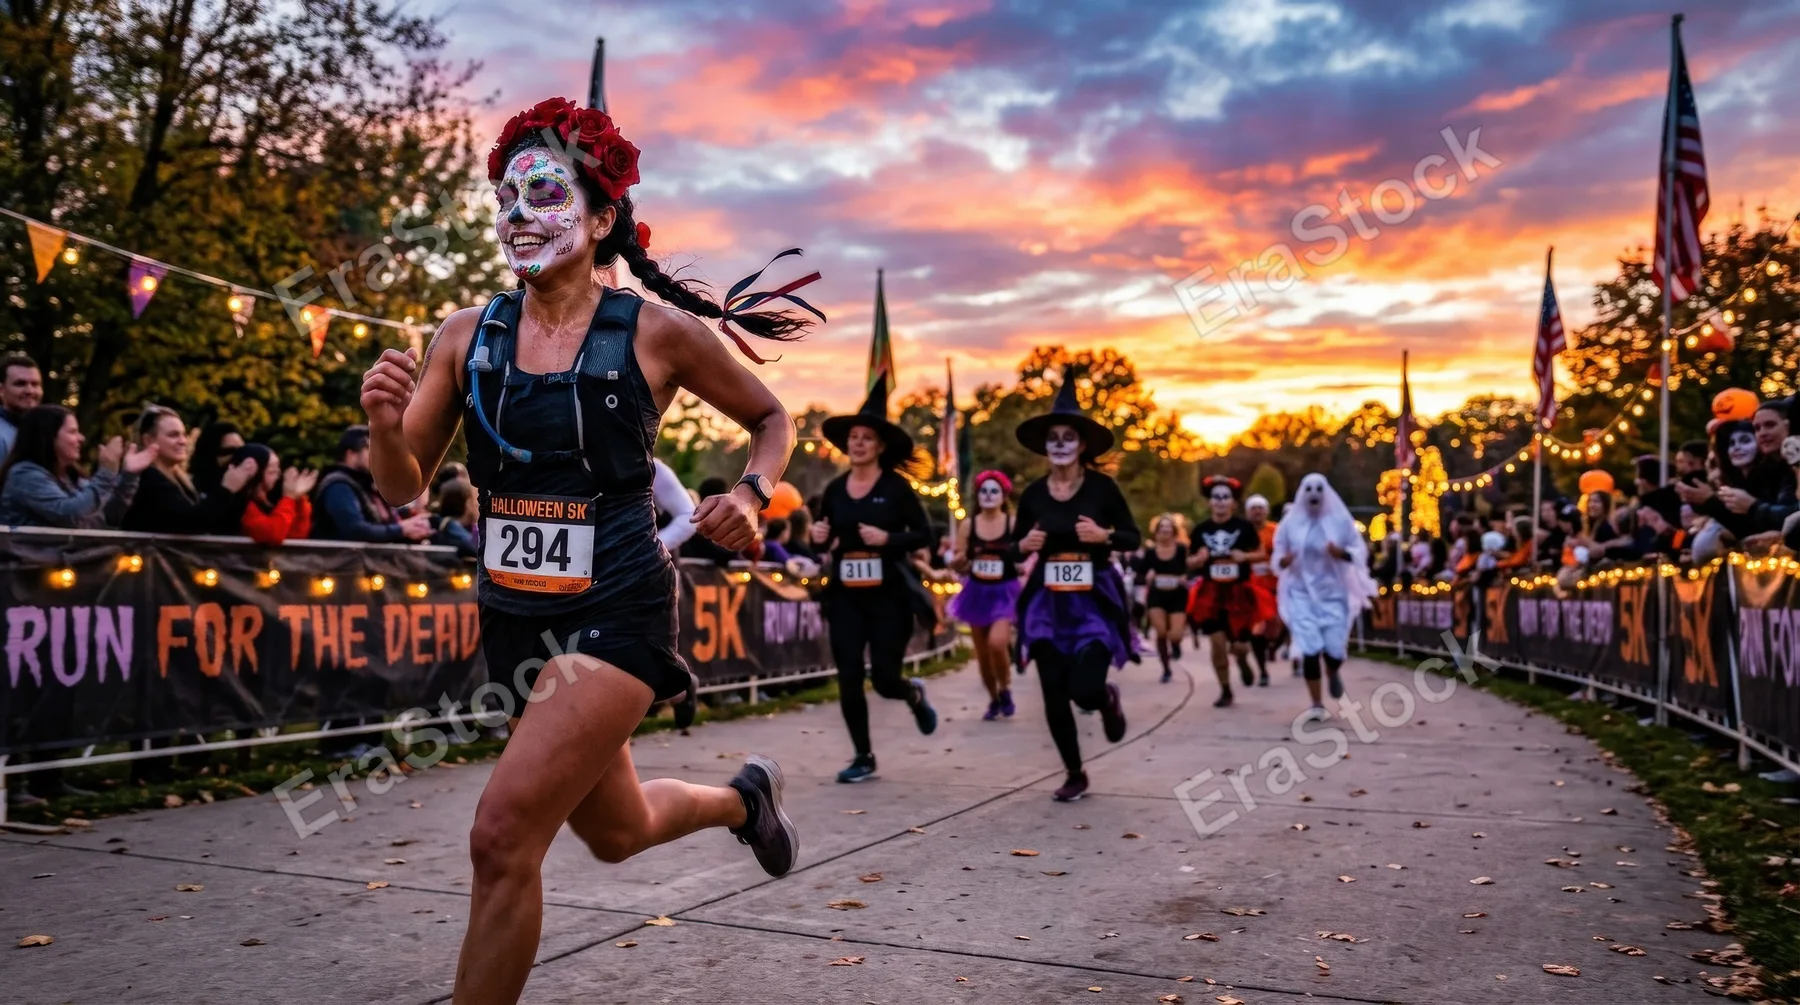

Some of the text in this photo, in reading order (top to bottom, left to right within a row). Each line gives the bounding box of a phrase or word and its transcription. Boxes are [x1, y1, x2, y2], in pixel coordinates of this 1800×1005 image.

[491, 497, 564, 518] HALLOWEEN
[500, 524, 571, 571] 294
[1053, 564, 1083, 582] 182
[4, 603, 480, 688] RUN FOR THE DEAD
[691, 584, 748, 663] 5K
[1620, 585, 1651, 666] 5K
